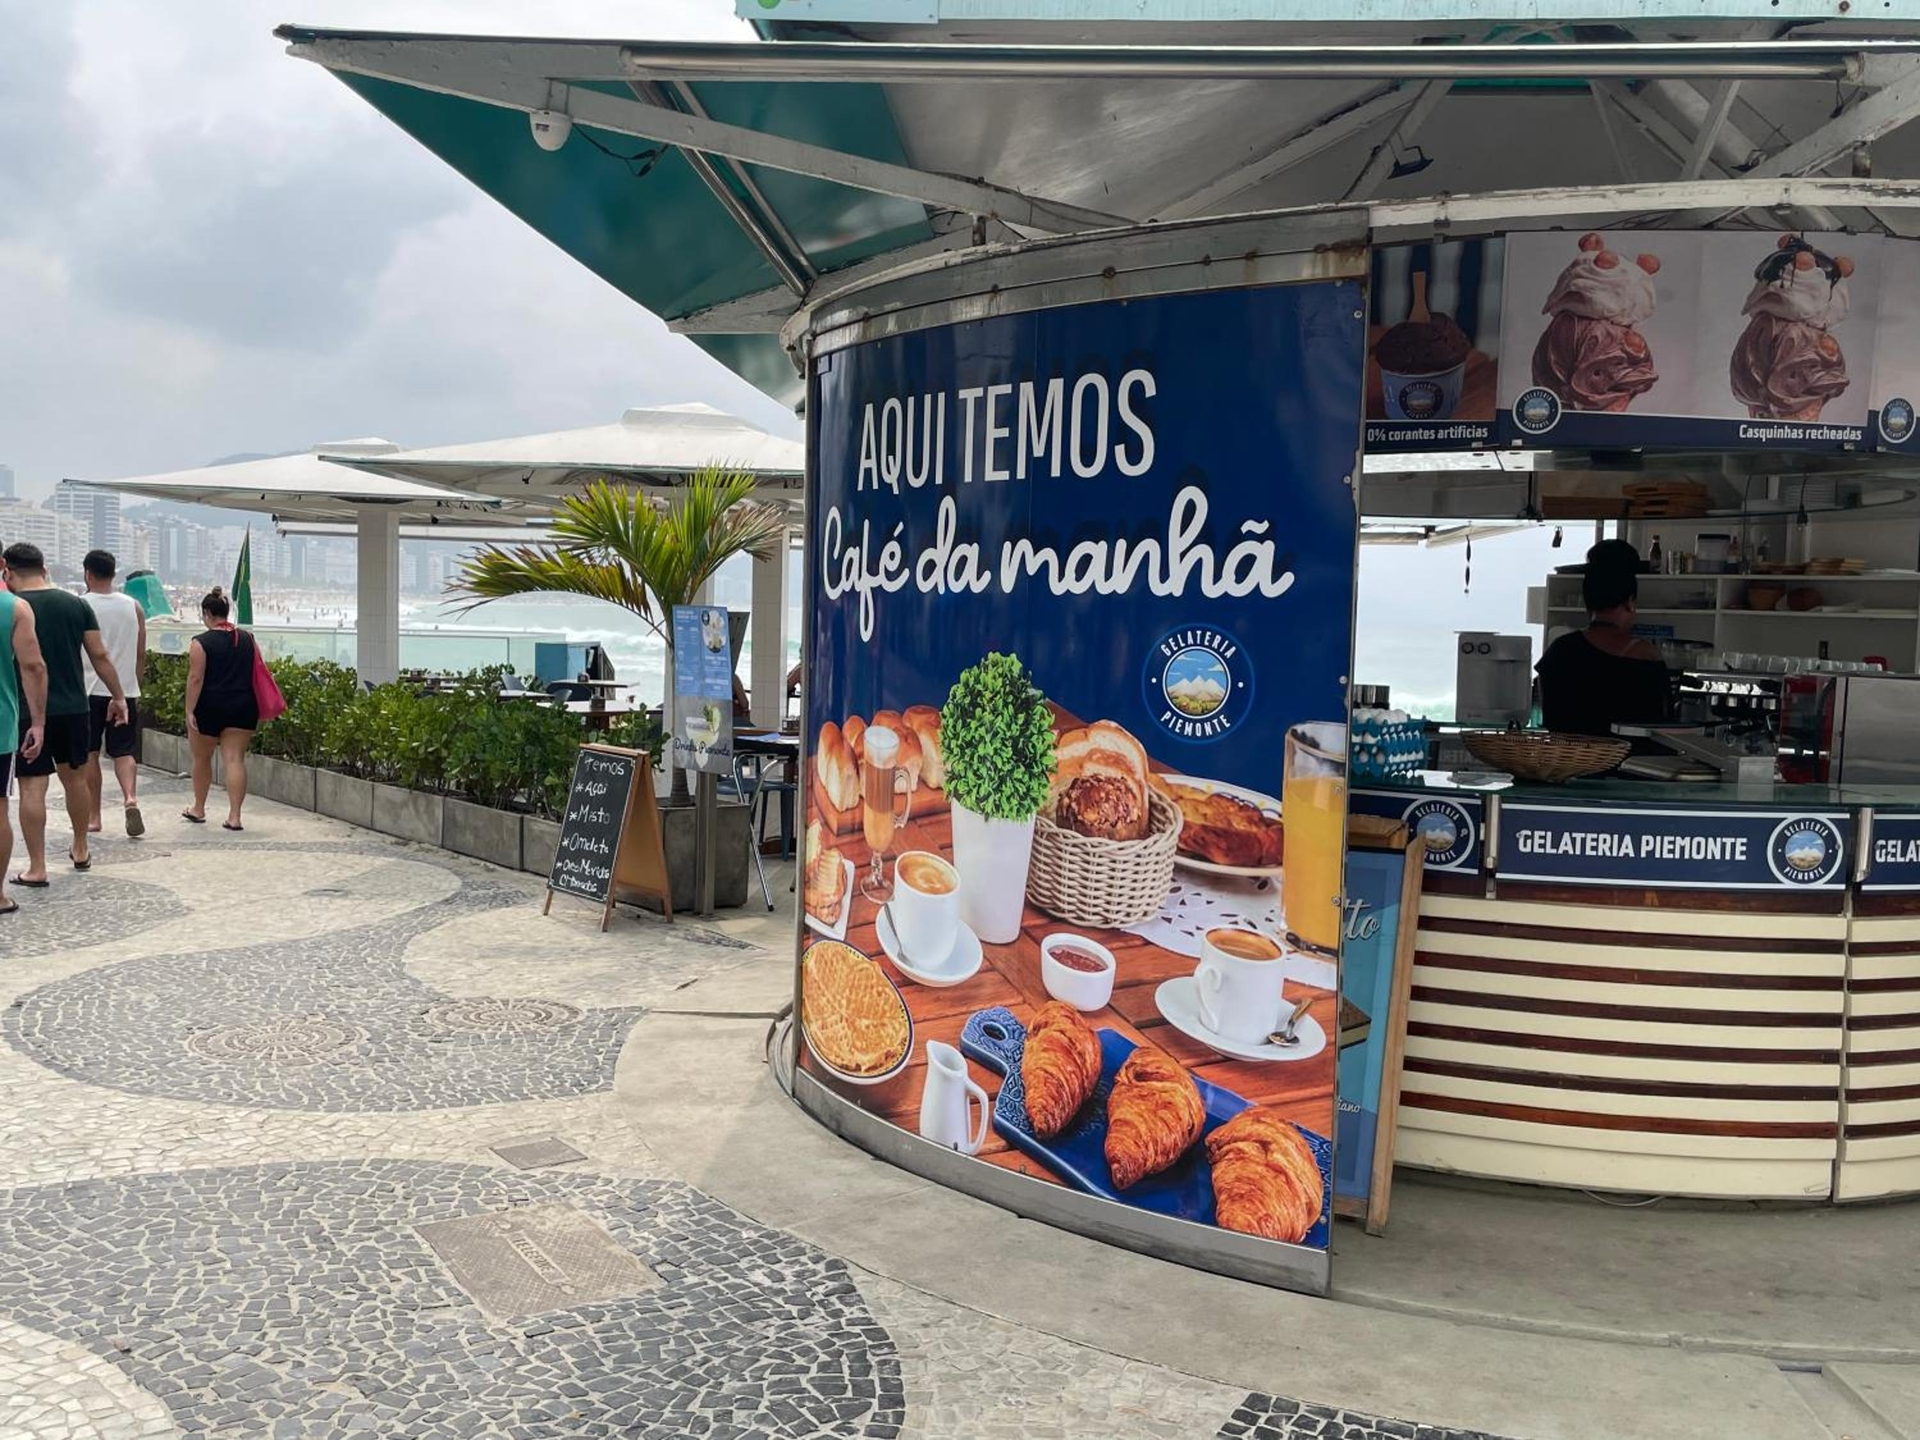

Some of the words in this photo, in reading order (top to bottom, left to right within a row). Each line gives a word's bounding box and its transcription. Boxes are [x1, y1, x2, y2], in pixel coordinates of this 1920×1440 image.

[857, 391, 945, 495] AQUI
[958, 369, 1157, 483] TEMOS
[1367, 428, 1386, 442] 0%
[1388, 427, 1436, 441] corantes
[1437, 425, 1488, 439] artificias
[1739, 424, 1803, 442] Casquinhas
[1805, 426, 1862, 441] recheadas
[823, 506, 910, 643] Café
[916, 495, 991, 595] da
[1001, 486, 1295, 599] manhã
[1160, 630, 1236, 659] GELATERIA
[1160, 711, 1231, 737] PIEMONTE
[577, 803, 610, 825] Misto
[1415, 803, 1460, 821] GELATERIA
[1784, 821, 1829, 837] GELATERIA
[1517, 829, 1635, 858] GELATERIA
[1640, 835, 1747, 861] PIEMONTE
[1783, 866, 1825, 881] PIEMONTE
